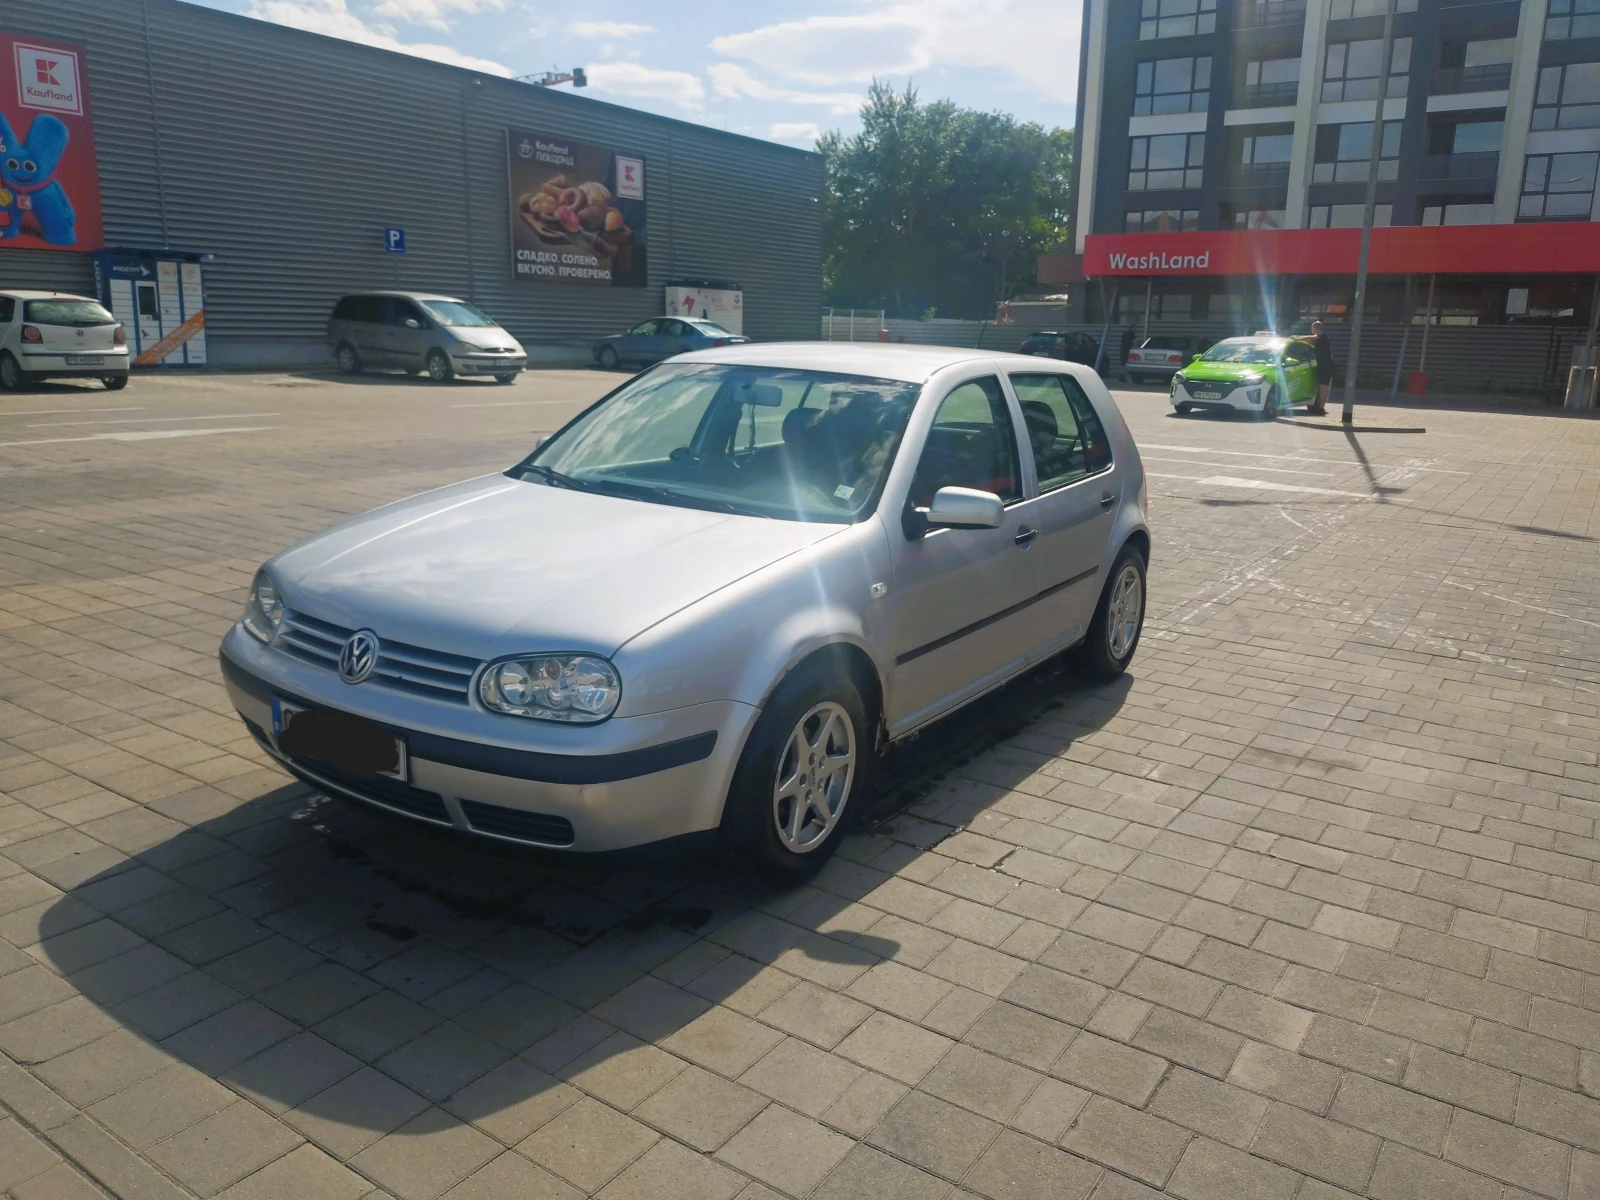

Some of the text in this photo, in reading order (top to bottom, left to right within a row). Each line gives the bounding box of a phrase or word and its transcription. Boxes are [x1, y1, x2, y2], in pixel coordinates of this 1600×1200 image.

[26, 86, 73, 102] Kaufland
[390, 230, 401, 247] P
[517, 249, 600, 267] СЛАДКО. СОЛЕНО.
[1109, 251, 1210, 270] WashLand
[517, 263, 613, 280] ВКУСНО. ПРОВЕРЕНО.
